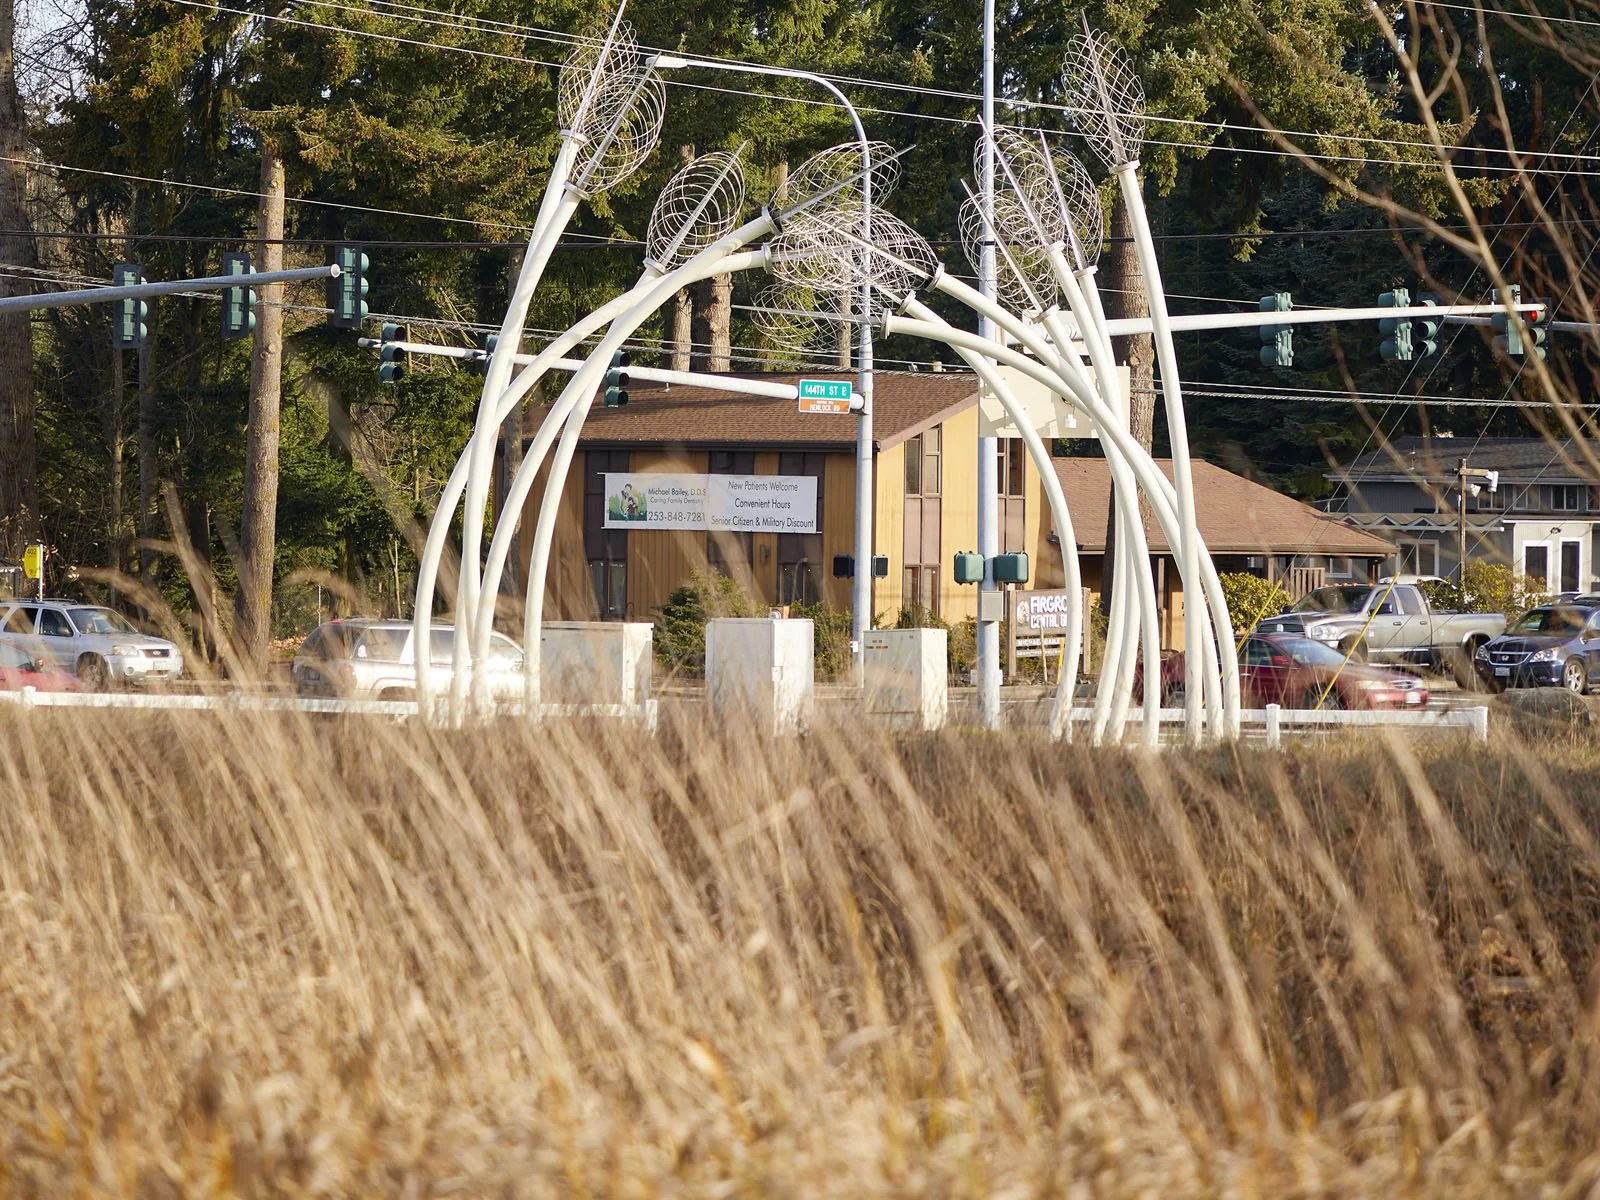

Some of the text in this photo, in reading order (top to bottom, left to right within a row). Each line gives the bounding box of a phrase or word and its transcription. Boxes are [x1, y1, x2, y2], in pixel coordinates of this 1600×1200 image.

[805, 384, 847, 396] 144TH ST E
[728, 481, 798, 491] New Patients Welcome
[648, 488, 670, 496] Michael
[671, 488, 689, 497] Bailey,
[734, 498, 791, 509] Convenient Hours
[648, 512, 705, 522] 253-848-7281
[711, 515, 814, 528] Senior Citizen & Military Discount
[1030, 595, 1067, 613] FIRGRO
